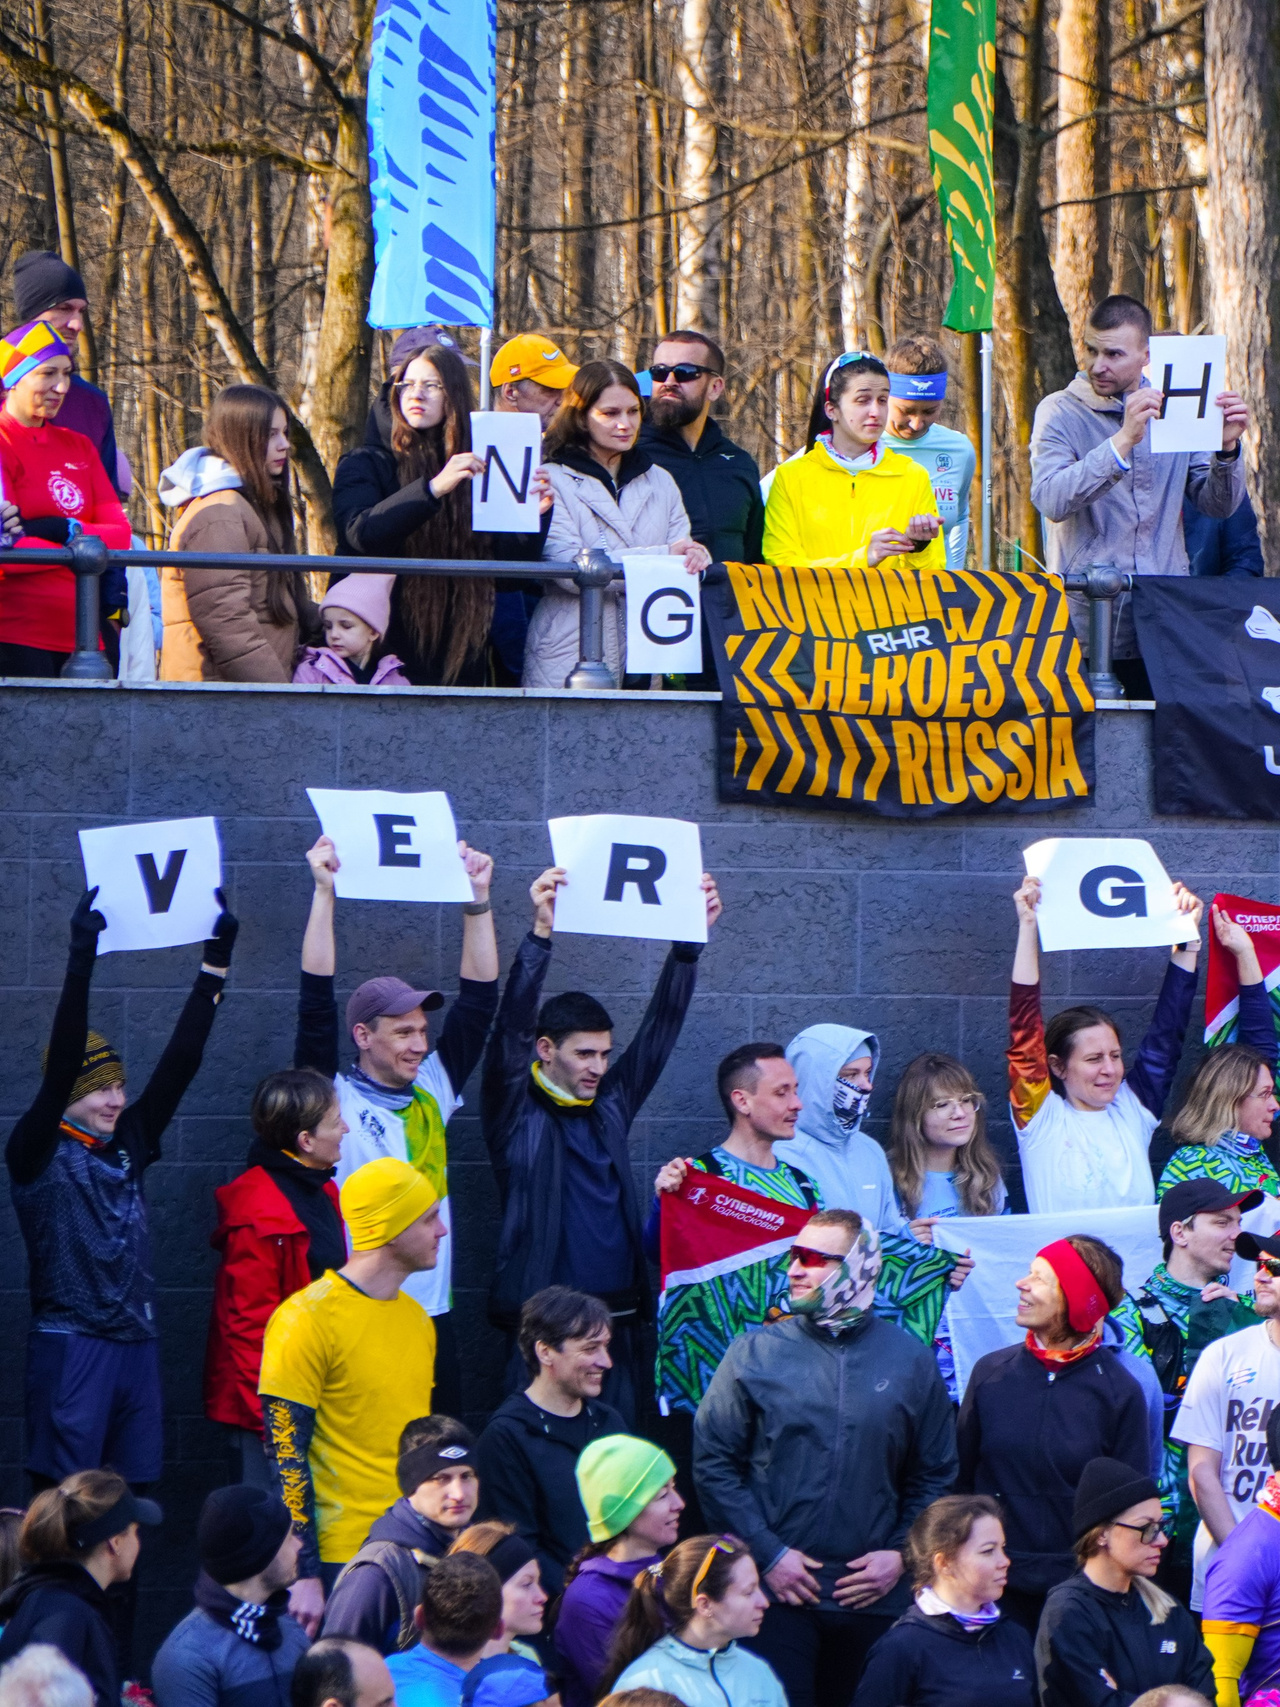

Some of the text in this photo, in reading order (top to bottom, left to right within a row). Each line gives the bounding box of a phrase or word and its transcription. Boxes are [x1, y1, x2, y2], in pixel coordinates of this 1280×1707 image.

[1158, 362, 1211, 420] H
[480, 445, 532, 503] N
[934, 487, 954, 501] IVE
[640, 587, 694, 645] G
[724, 562, 962, 643] RUNNING
[866, 625, 933, 655] RHR
[808, 639, 1012, 718] HEROES
[892, 716, 1089, 805] RUSSIA
[373, 813, 421, 868] E
[134, 848, 188, 914] V
[603, 842, 668, 906] R
[1079, 865, 1148, 918] G
[710, 1203, 780, 1232] ПОДМОСКОВЬЯ
[715, 1194, 785, 1226] СУПЕРЛИГА
